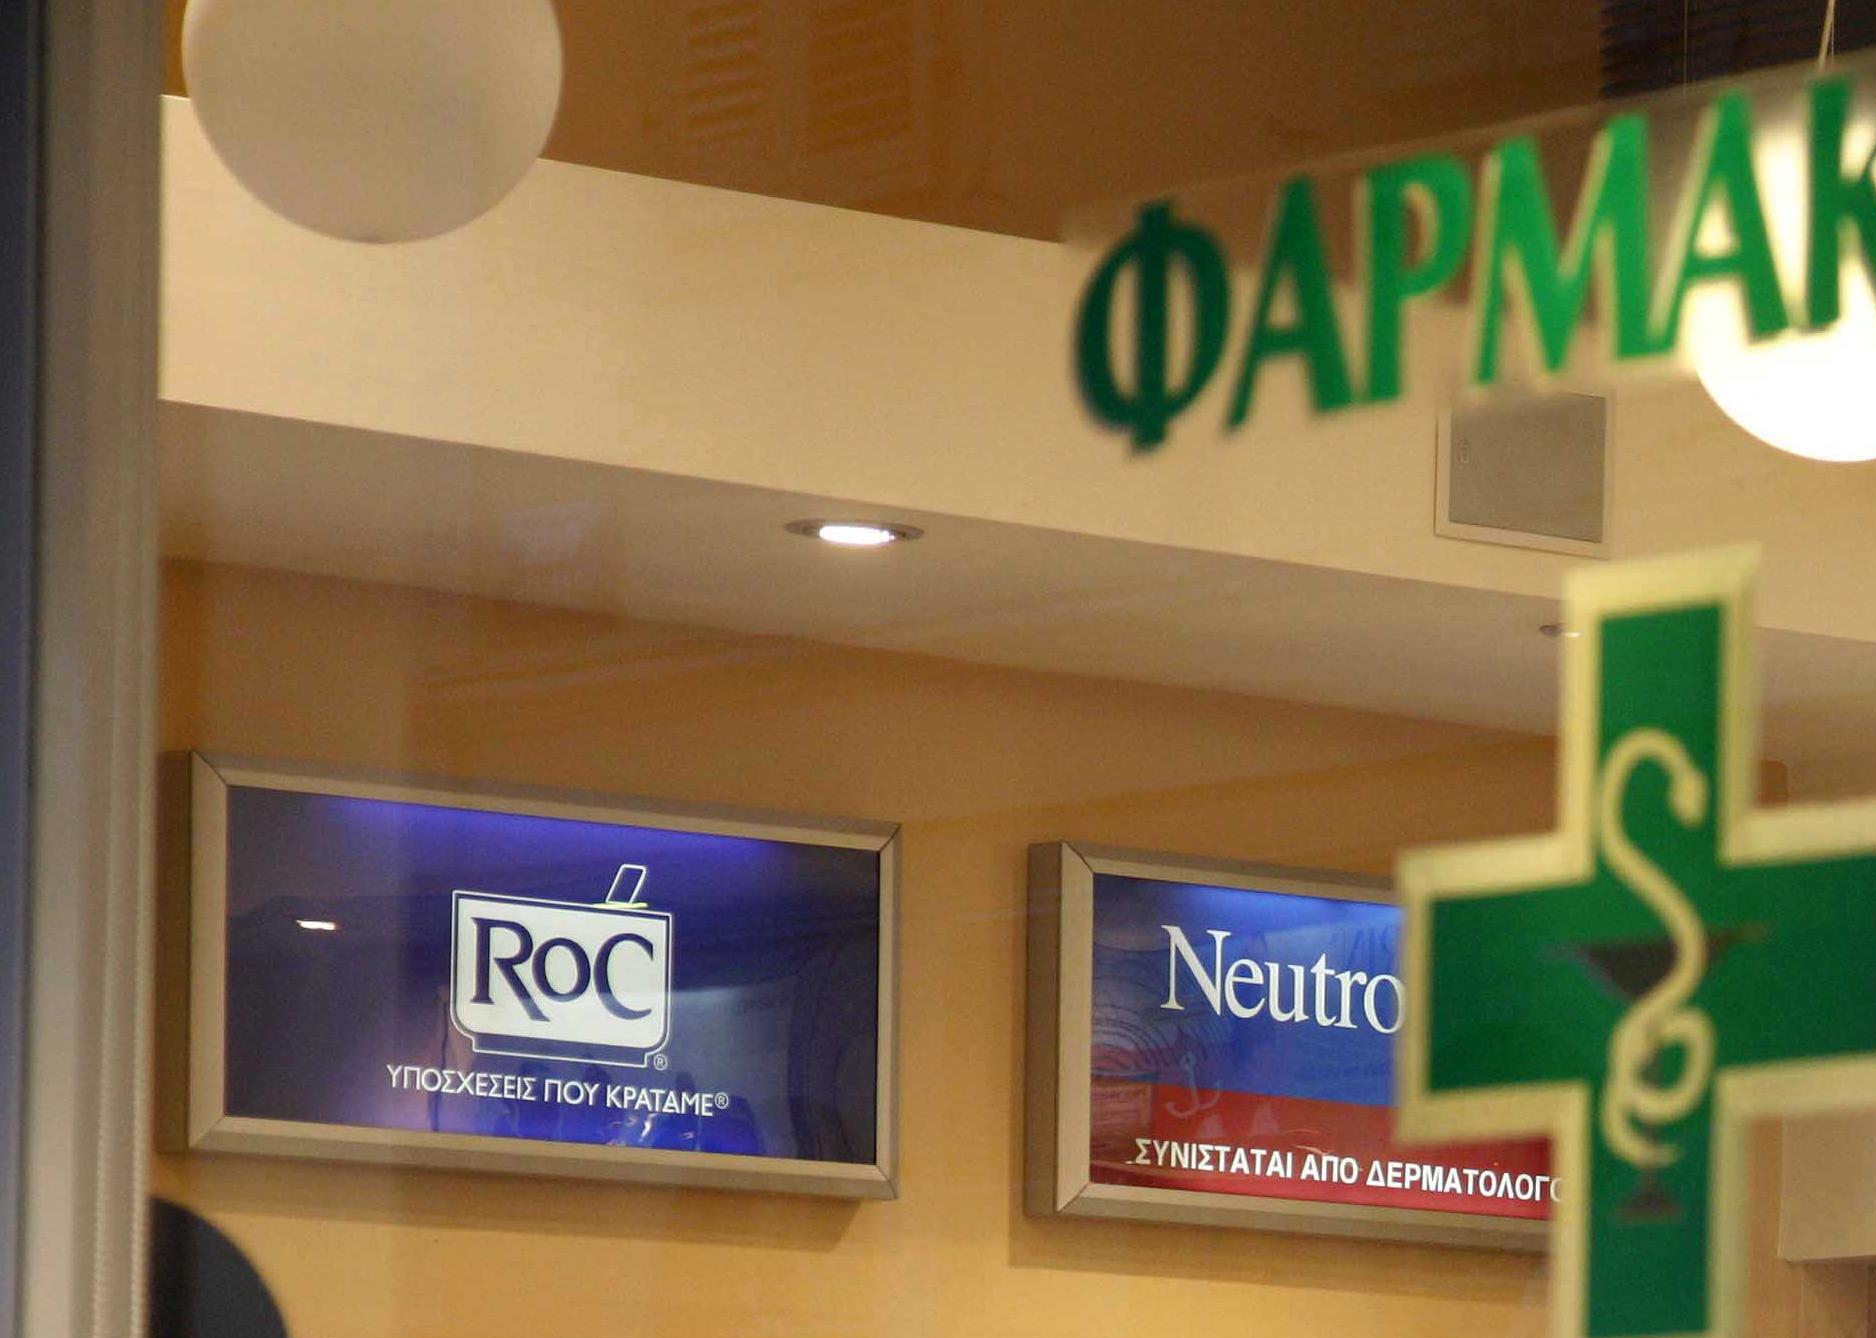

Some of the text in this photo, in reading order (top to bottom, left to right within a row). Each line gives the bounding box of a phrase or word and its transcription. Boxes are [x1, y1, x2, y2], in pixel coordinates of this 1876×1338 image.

[1160, 924, 1407, 1035] Neutro
[386, 1064, 537, 1101] ΥΠΟΣΧΕΣΕΙΣ
[544, 1080, 598, 1107] ΠΟΥ
[1135, 1137, 1563, 1203] ΣΥΝΙΣΤΑΤΑΙ ΑΠΟ ΔΕΡΜΑΤΟΛΟΓΟ
